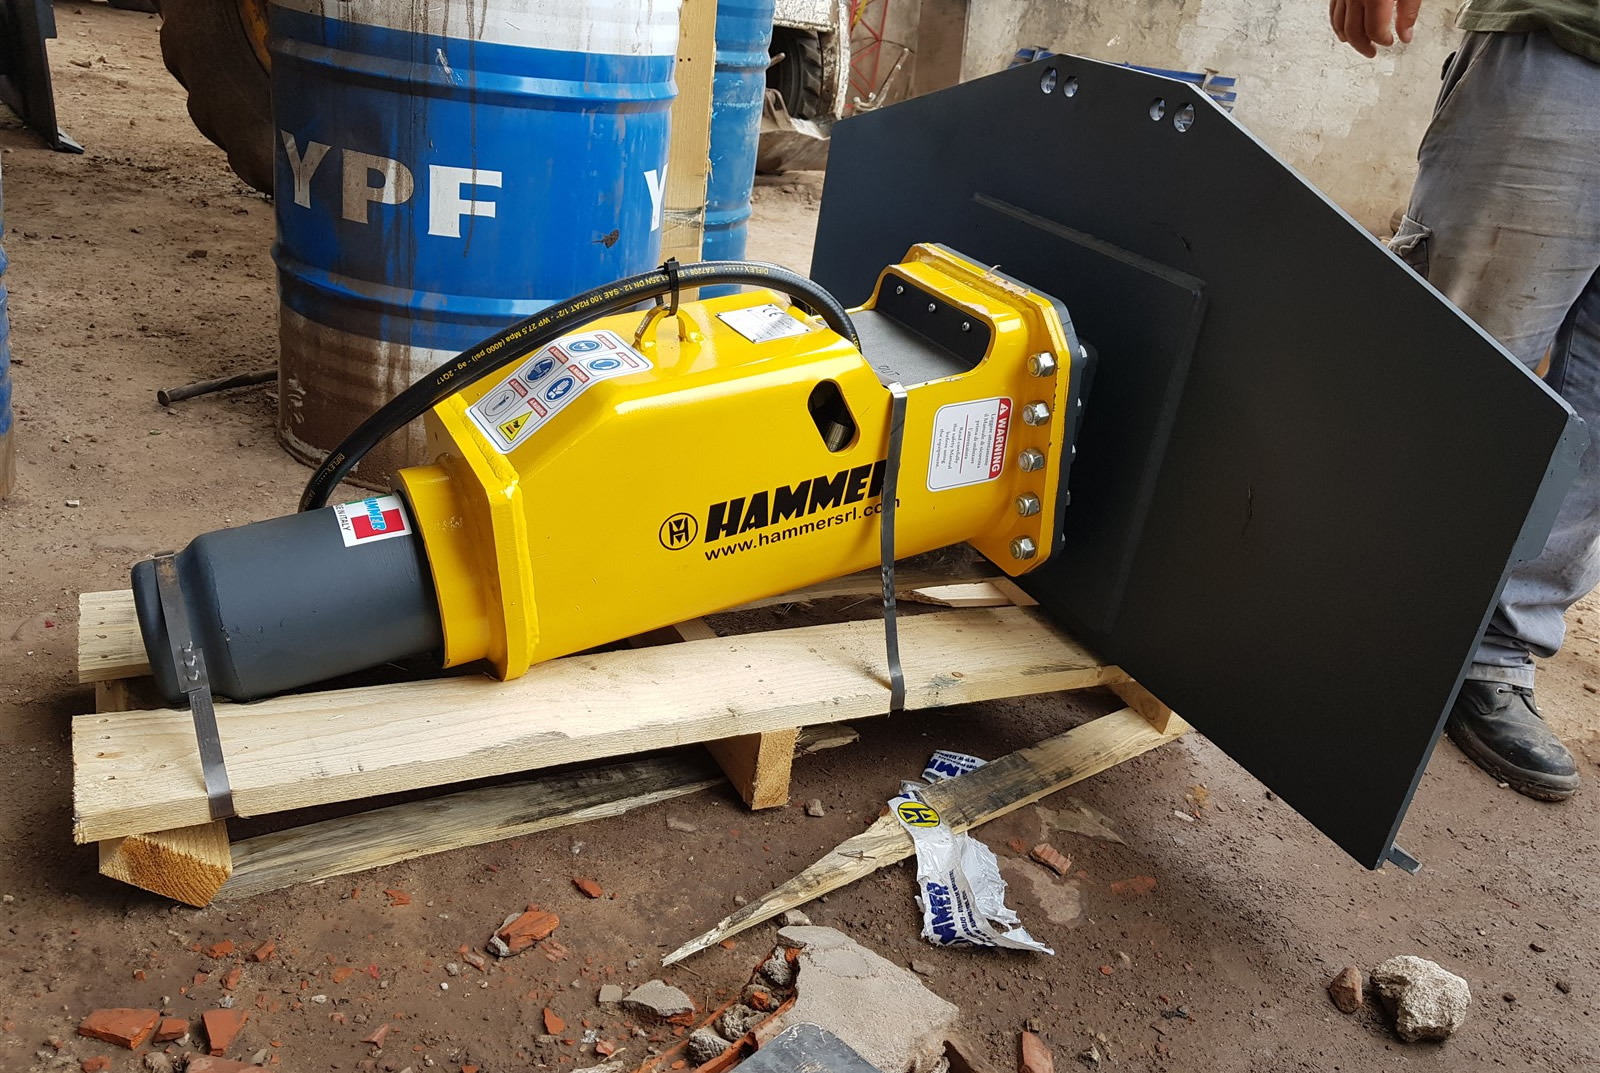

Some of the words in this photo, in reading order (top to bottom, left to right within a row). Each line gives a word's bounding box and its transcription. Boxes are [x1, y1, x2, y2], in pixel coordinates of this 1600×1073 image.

[280, 129, 502, 238] YPF
[744, 265, 769, 275] DIFLEX
[604, 288, 620, 299] SAE
[624, 283, 633, 292] 12
[590, 294, 603, 304] 100
[570, 299, 590, 313] R2AT
[538, 316, 551, 328] WP
[486, 338, 506, 355] (4000
[991, 417, 1006, 472] WARNING
